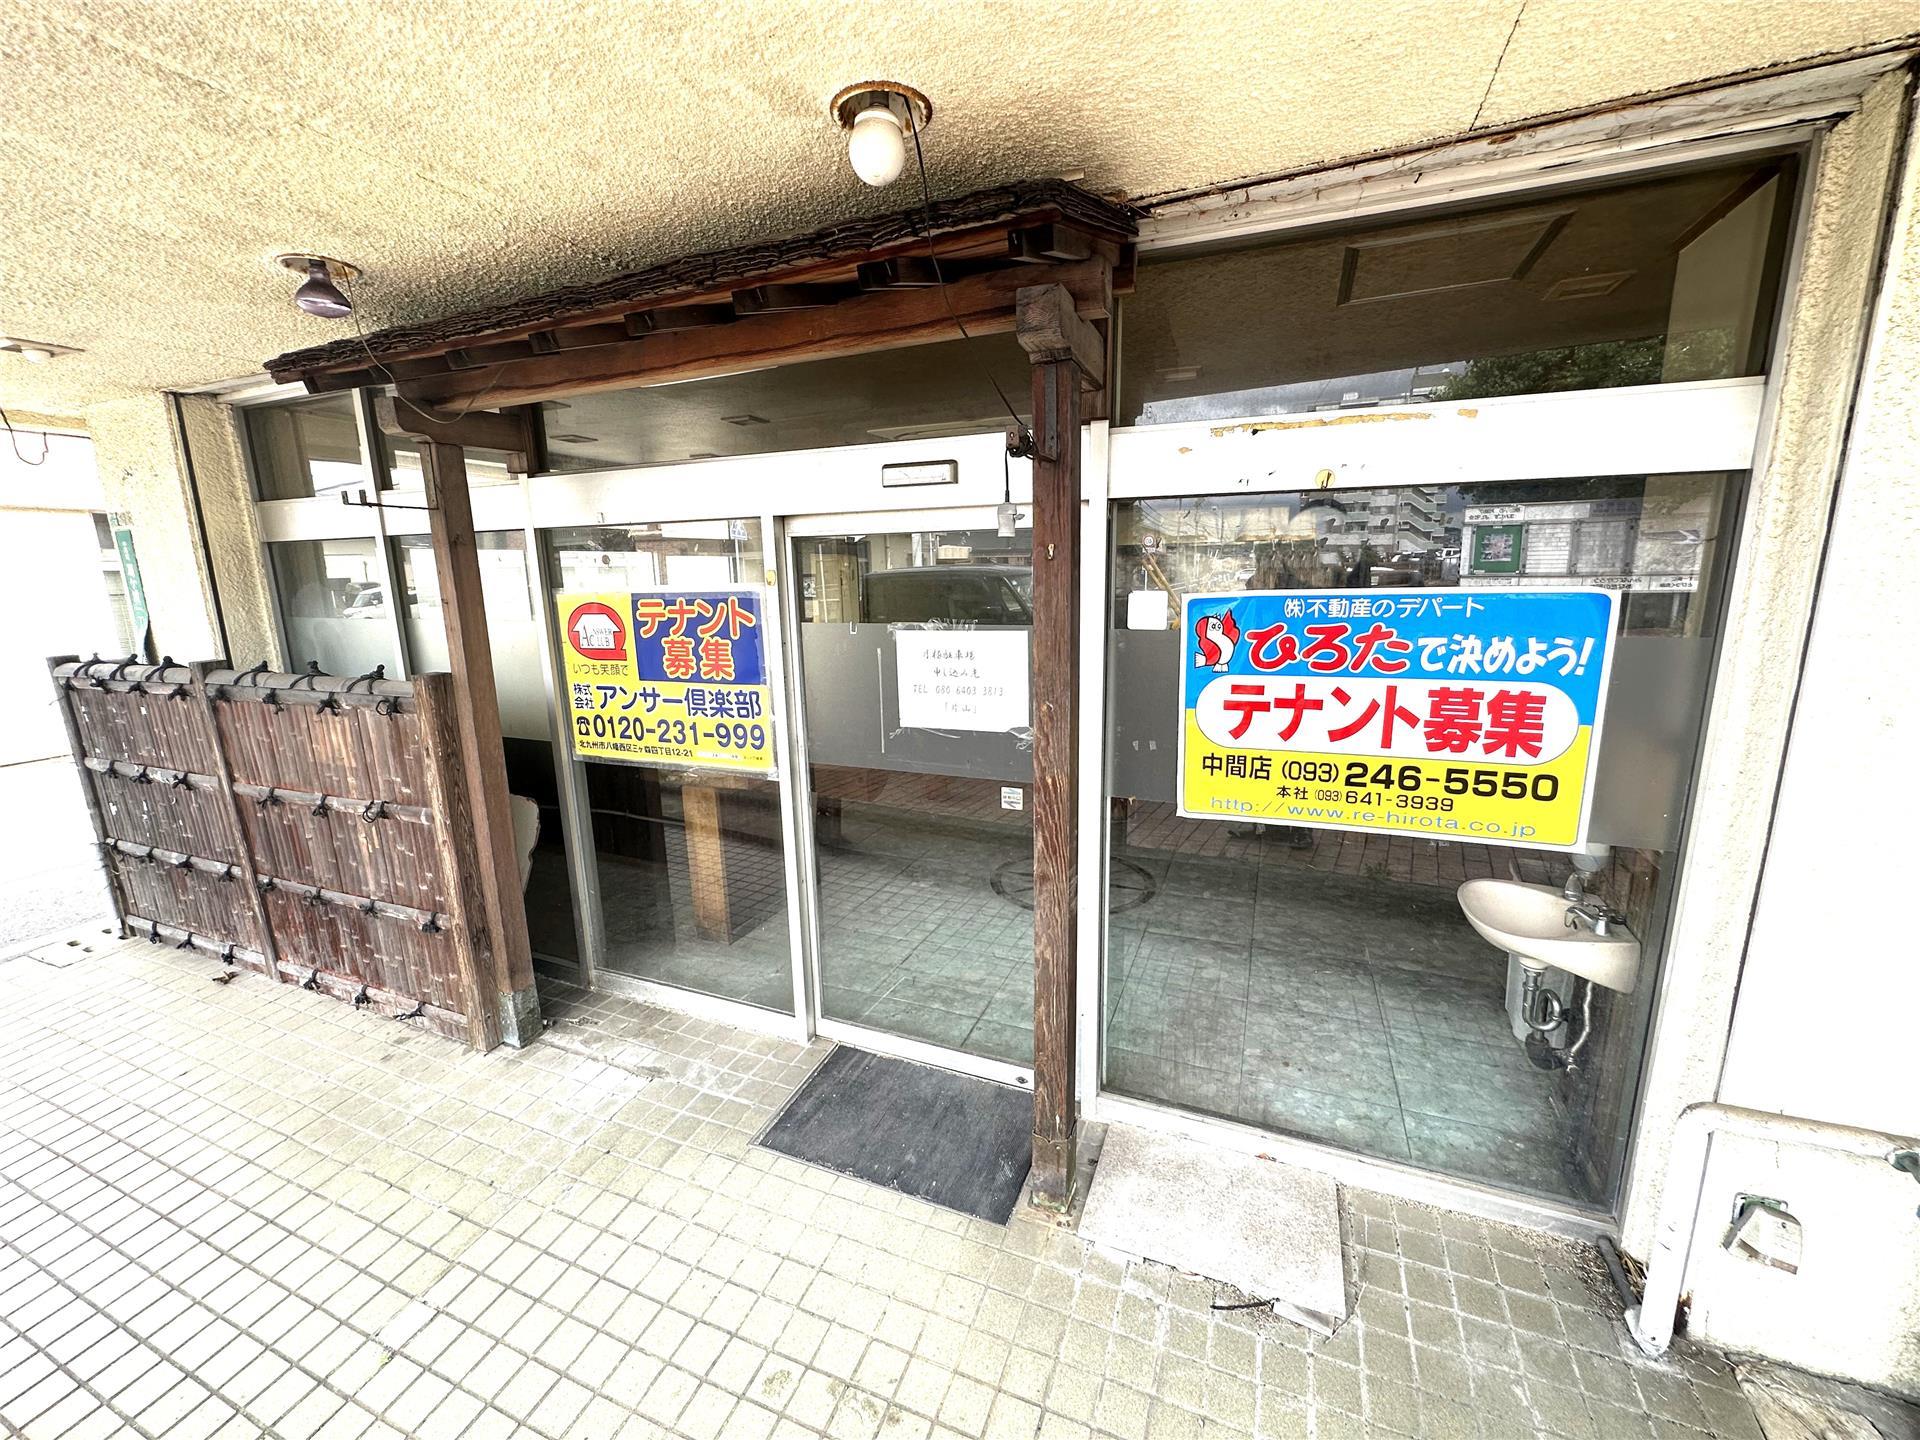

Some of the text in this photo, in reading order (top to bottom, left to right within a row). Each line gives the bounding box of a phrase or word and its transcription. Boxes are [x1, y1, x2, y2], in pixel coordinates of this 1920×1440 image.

[635, 595, 756, 638] テナント
[573, 663, 629, 678] いつも笑顔で
[662, 637, 735, 680] 募集
[573, 683, 593, 696] 株式
[574, 696, 595, 710] 会社
[596, 684, 762, 720] アンサー倶楽部
[913, 684, 928, 695] TEL
[935, 685, 951, 695] 080
[593, 713, 765, 751] 0120-231-999
[1223, 683, 1547, 758] テナント募集
[1202, 752, 1272, 781] 中間店
[1276, 785, 1309, 801] 本社
[1211, 796, 1536, 838] http://www.re-hirota.co.jp
